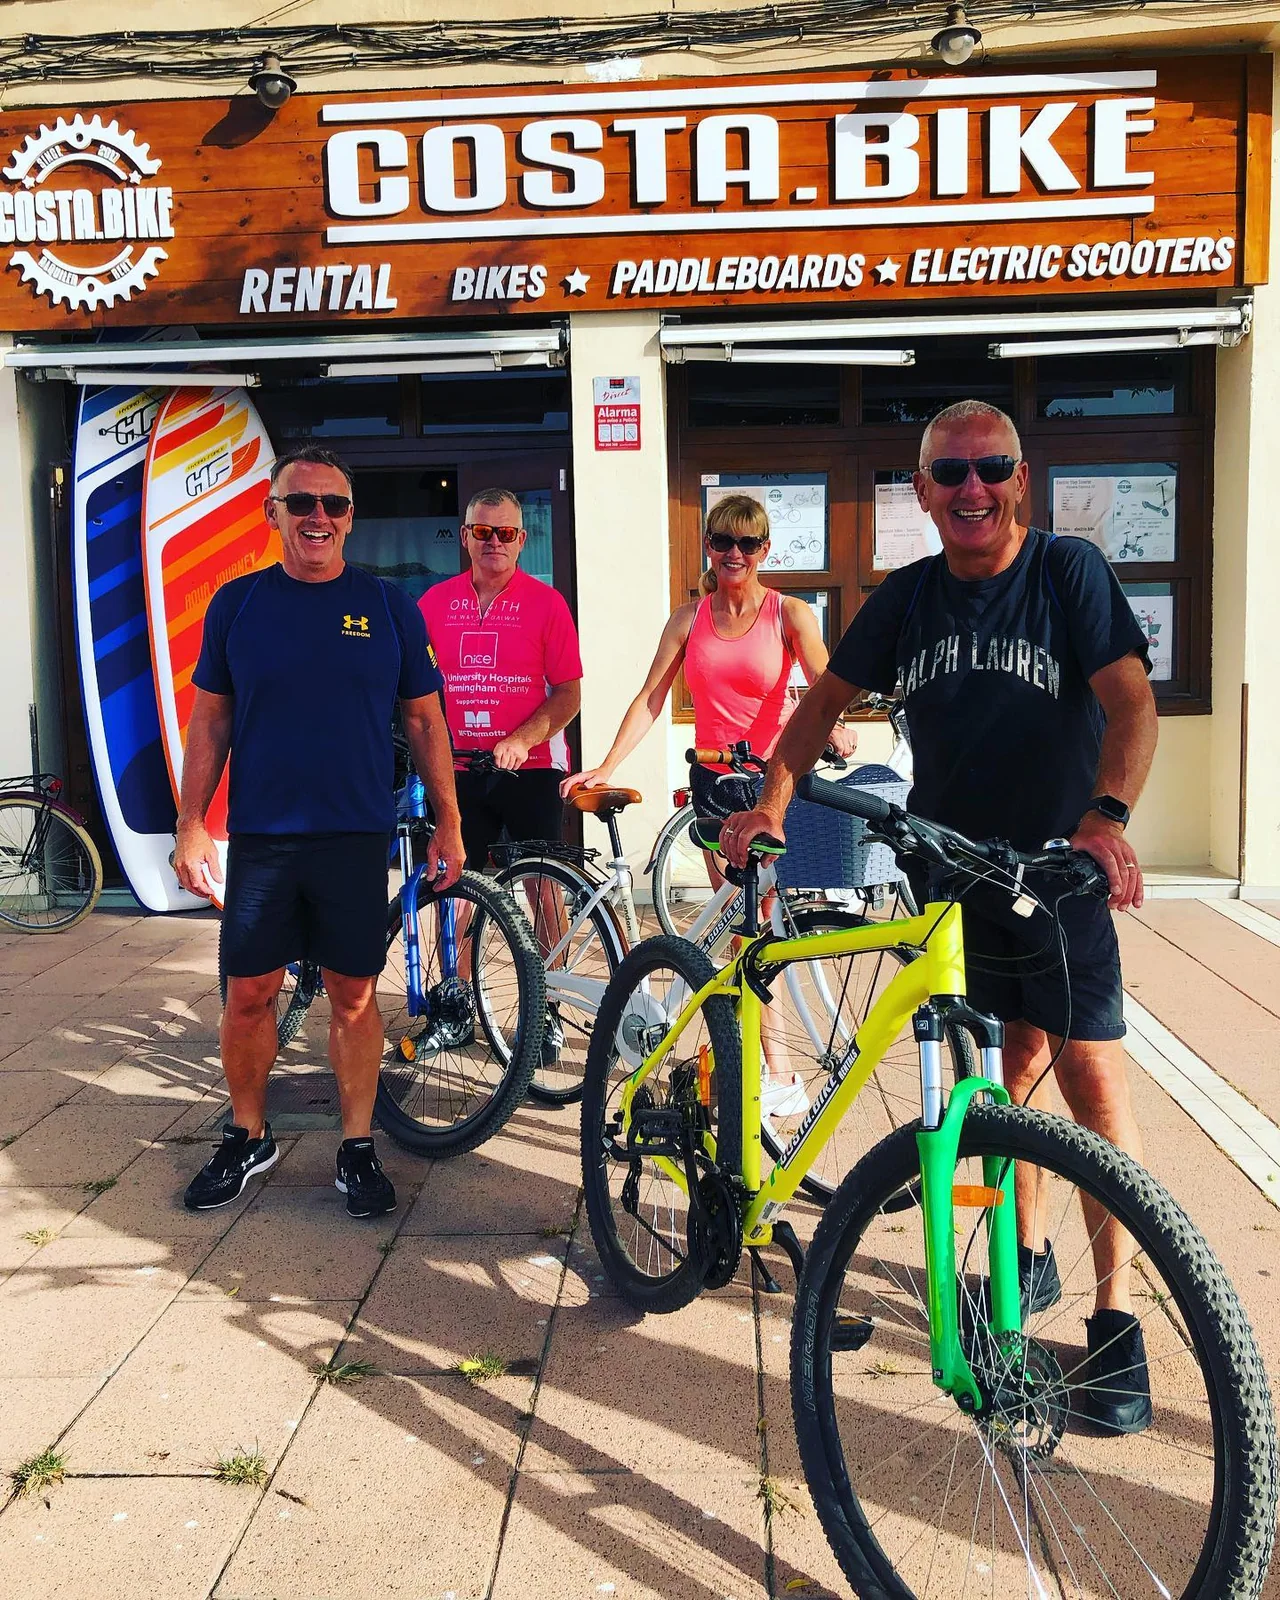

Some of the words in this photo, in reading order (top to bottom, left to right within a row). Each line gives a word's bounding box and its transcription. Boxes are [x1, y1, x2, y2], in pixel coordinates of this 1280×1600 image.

[326, 96, 1157, 218] COSTA.BIKE
[0, 187, 175, 242] COSTA.BIKE
[239, 263, 398, 314] RENTAL
[451, 264, 548, 301] BIKES
[611, 253, 866, 294] PADDLEBOARDS
[910, 245, 1058, 284] ELECTRIC
[1066, 236, 1236, 280] SCOOTERS
[598, 407, 637, 417] Alarma
[341, 630, 371, 638] FREEDOM
[463, 654, 492, 665] nice
[447, 672, 487, 683] University
[489, 673, 532, 684] Hospitals
[448, 683, 497, 693] Birmingham
[499, 684, 530, 694] Charity
[970, 631, 1060, 700] LAUREN
[621, 898, 632, 932] London
[707, 892, 745, 944] COSTA.BI
[802, 1290, 820, 1412] MERIDA
